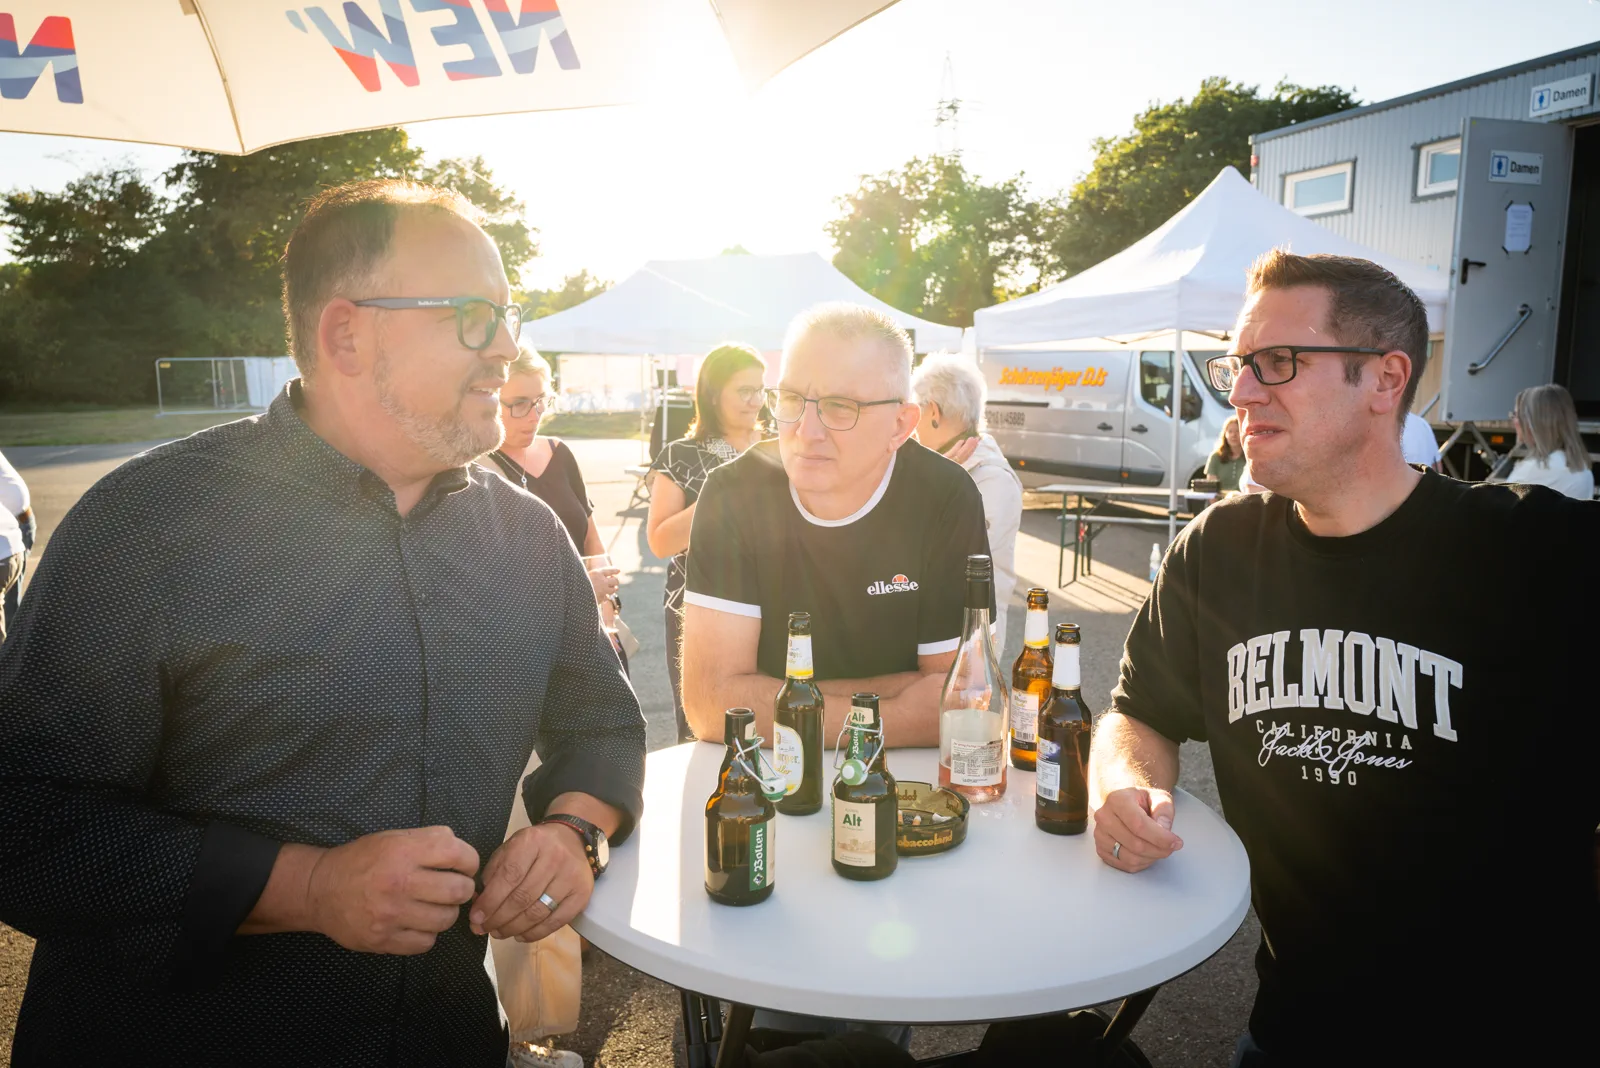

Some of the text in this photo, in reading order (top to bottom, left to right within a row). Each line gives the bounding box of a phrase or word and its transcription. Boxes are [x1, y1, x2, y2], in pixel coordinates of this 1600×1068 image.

[1552, 86, 1587, 102] Damen
[1510, 161, 1539, 174] Damen
[867, 580, 919, 595] ellesse
[1227, 628, 1463, 742] BELMONT
[852, 712, 865, 722] Alt
[1255, 719, 1413, 750] CALIFORNIA
[842, 813, 862, 827] Alt
[897, 829, 953, 848] obaccoland
[753, 828, 764, 872] Bolten
